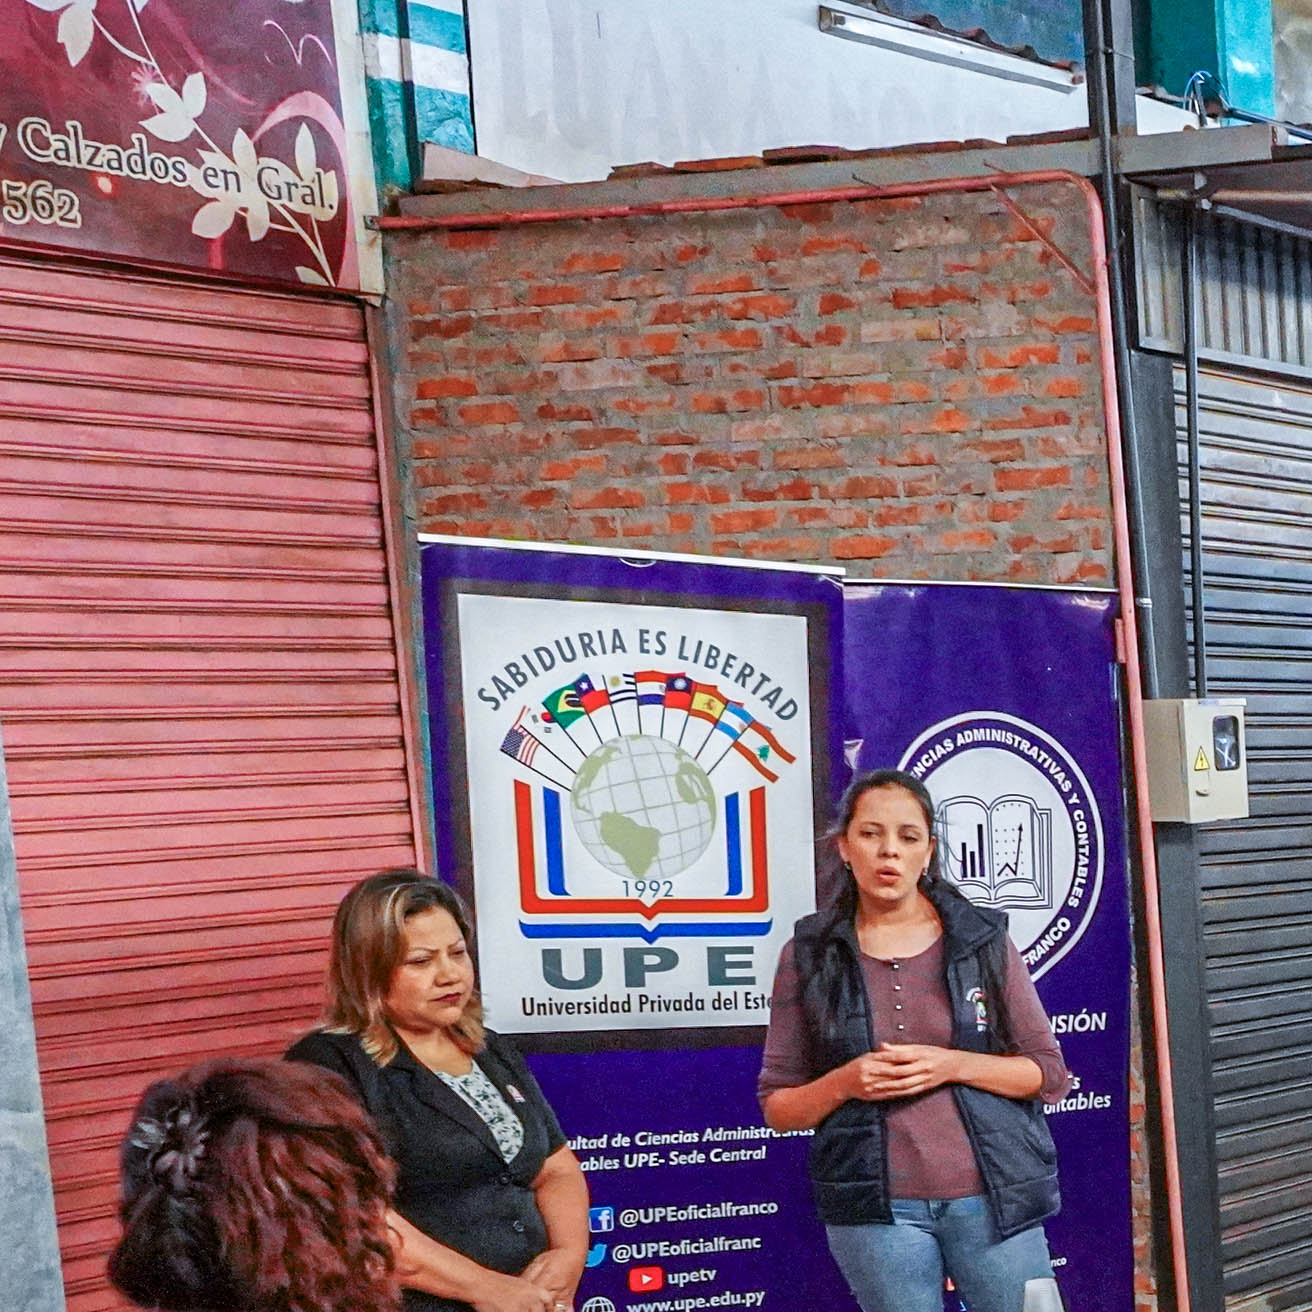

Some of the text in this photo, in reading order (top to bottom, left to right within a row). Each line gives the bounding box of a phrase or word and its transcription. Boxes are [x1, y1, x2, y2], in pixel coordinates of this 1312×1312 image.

[18, 117, 191, 187] Calzados
[202, 163, 242, 194] en
[256, 165, 335, 212] Gral.
[2, 180, 82, 228] 562
[477, 629, 799, 722] SABIDURIA ES LIBERTAD
[911, 728, 1089, 908] NCIAS ADMINISTRATIVAS Y CONTABLES
[623, 880, 673, 898] 1992
[1022, 917, 1071, 966] FRANCO
[541, 946, 757, 990] UPE
[521, 994, 631, 1016] Universidad
[639, 992, 705, 1014] Privada
[712, 991, 744, 1011] del
[1050, 1008, 1107, 1034] NSIÓN
[566, 1134, 608, 1150] ultad
[611, 1133, 631, 1148] de
[635, 1130, 699, 1146] Ciencias
[580, 1146, 767, 1172] ables UPE- Sede Central
[619, 1202, 778, 1228] @UPEoficialfranco
[612, 1237, 761, 1263] @UPEoficialfranc
[667, 1268, 717, 1287] upetv
